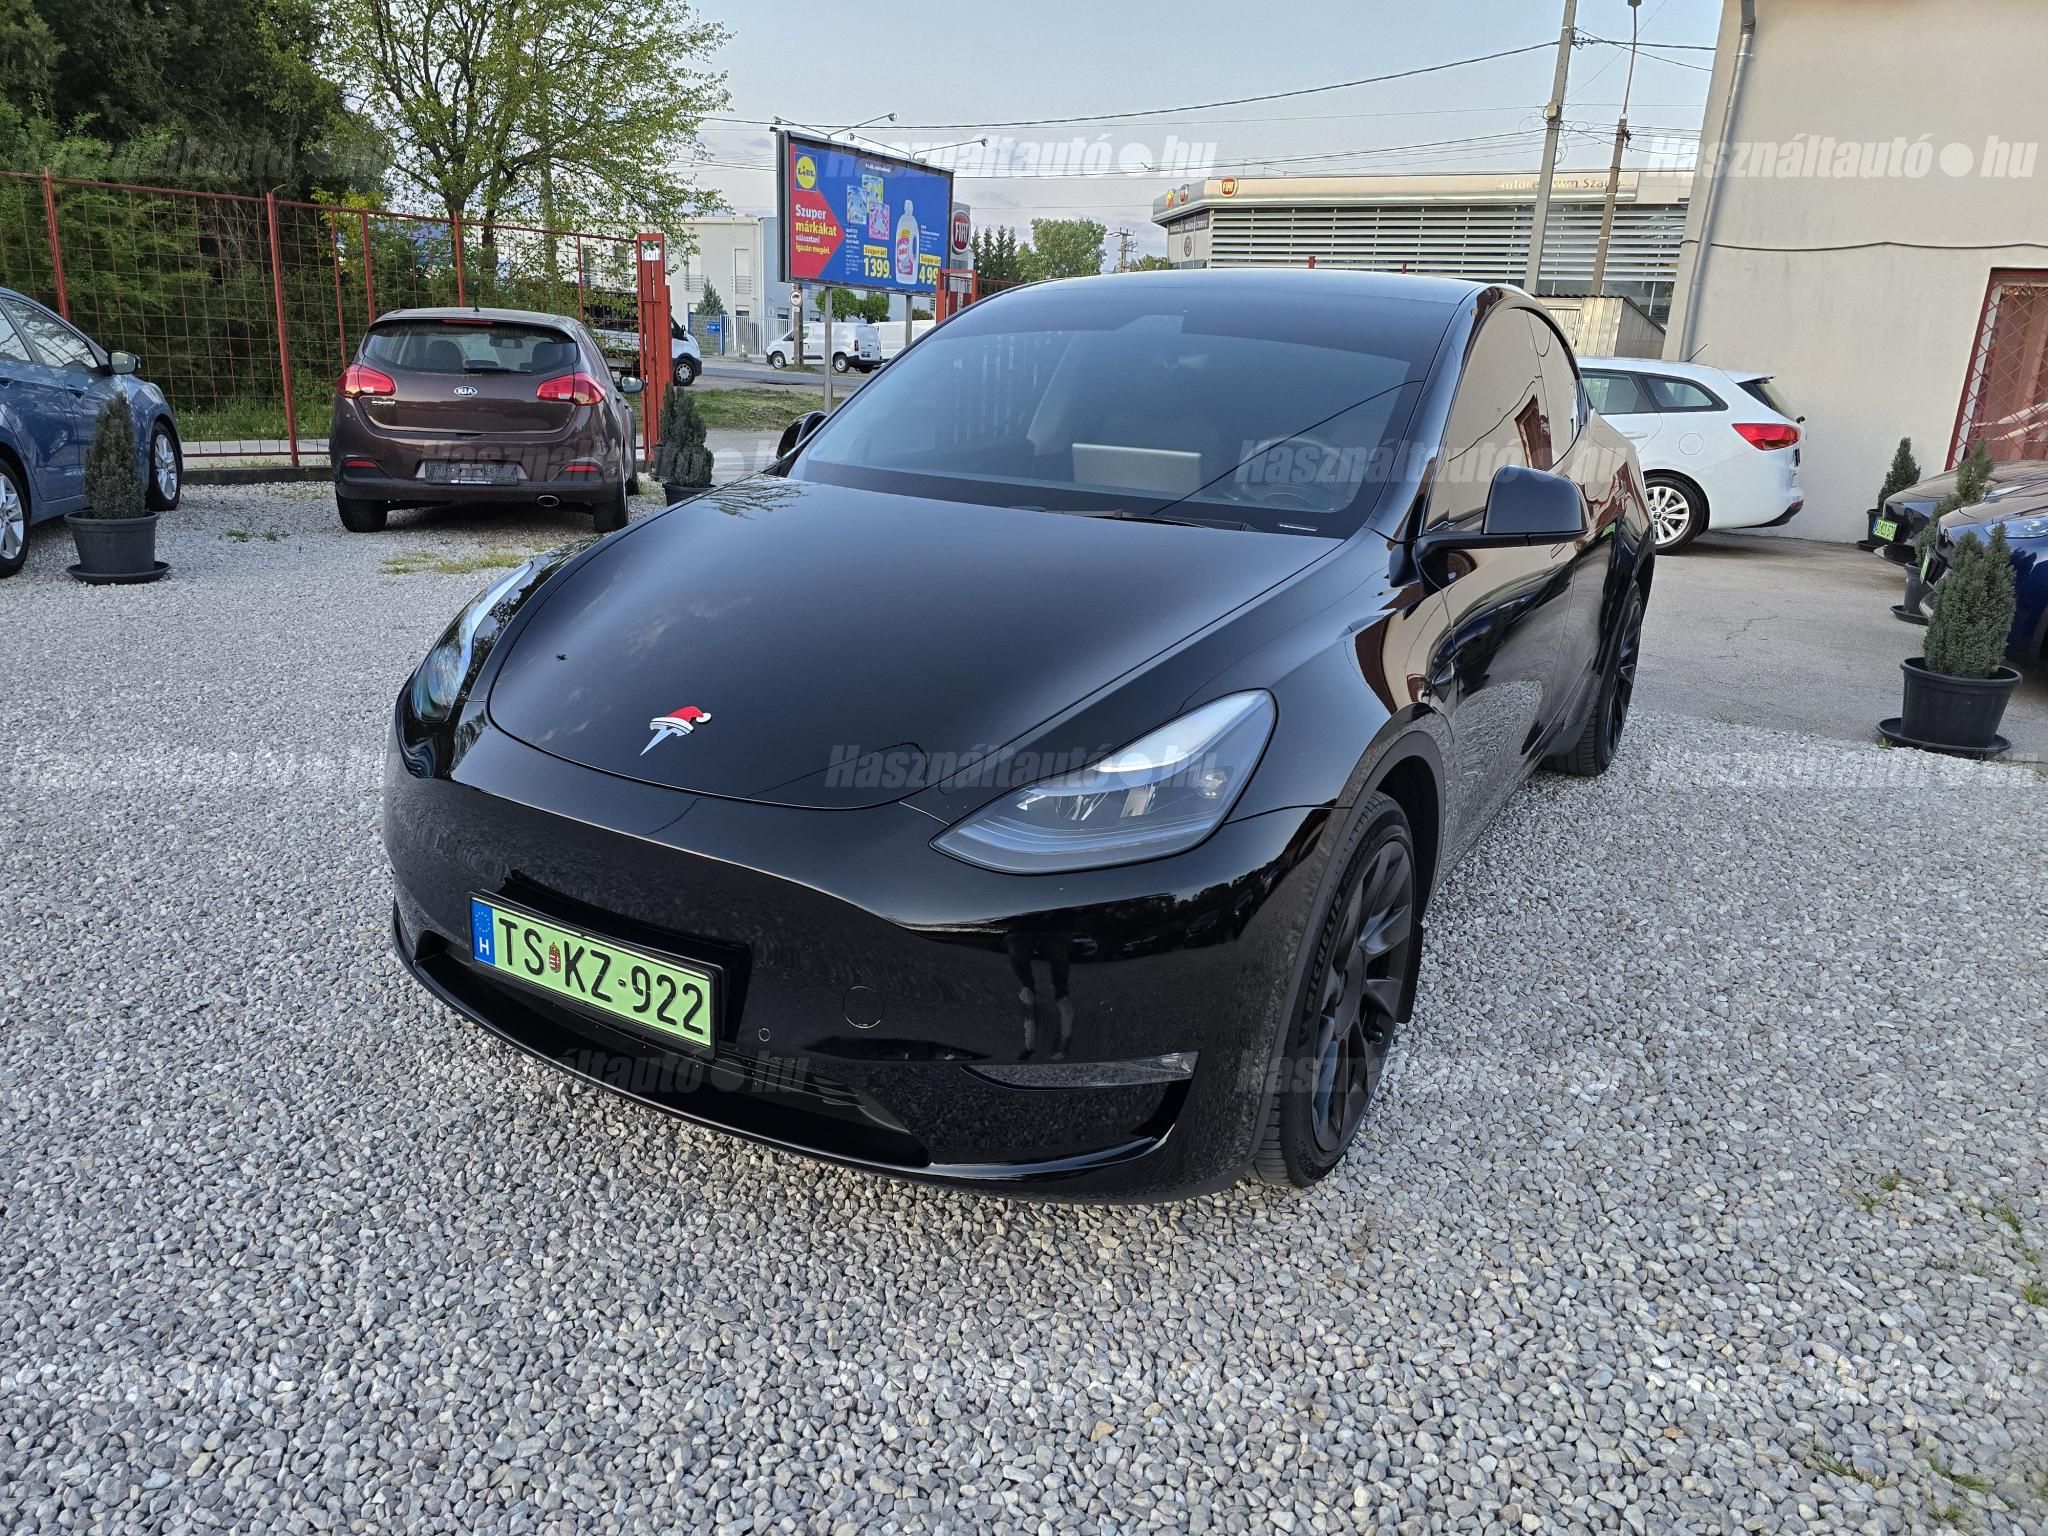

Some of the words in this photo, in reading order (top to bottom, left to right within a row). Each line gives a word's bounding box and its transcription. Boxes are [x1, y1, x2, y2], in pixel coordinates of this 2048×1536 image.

[1496, 179, 1579, 190] Autócerum
[1583, 178, 1621, 189] Sza
[795, 203, 827, 220] Szuper
[795, 220, 837, 237] márkákat
[955, 221, 969, 243] FIAT
[478, 936, 490, 956] H
